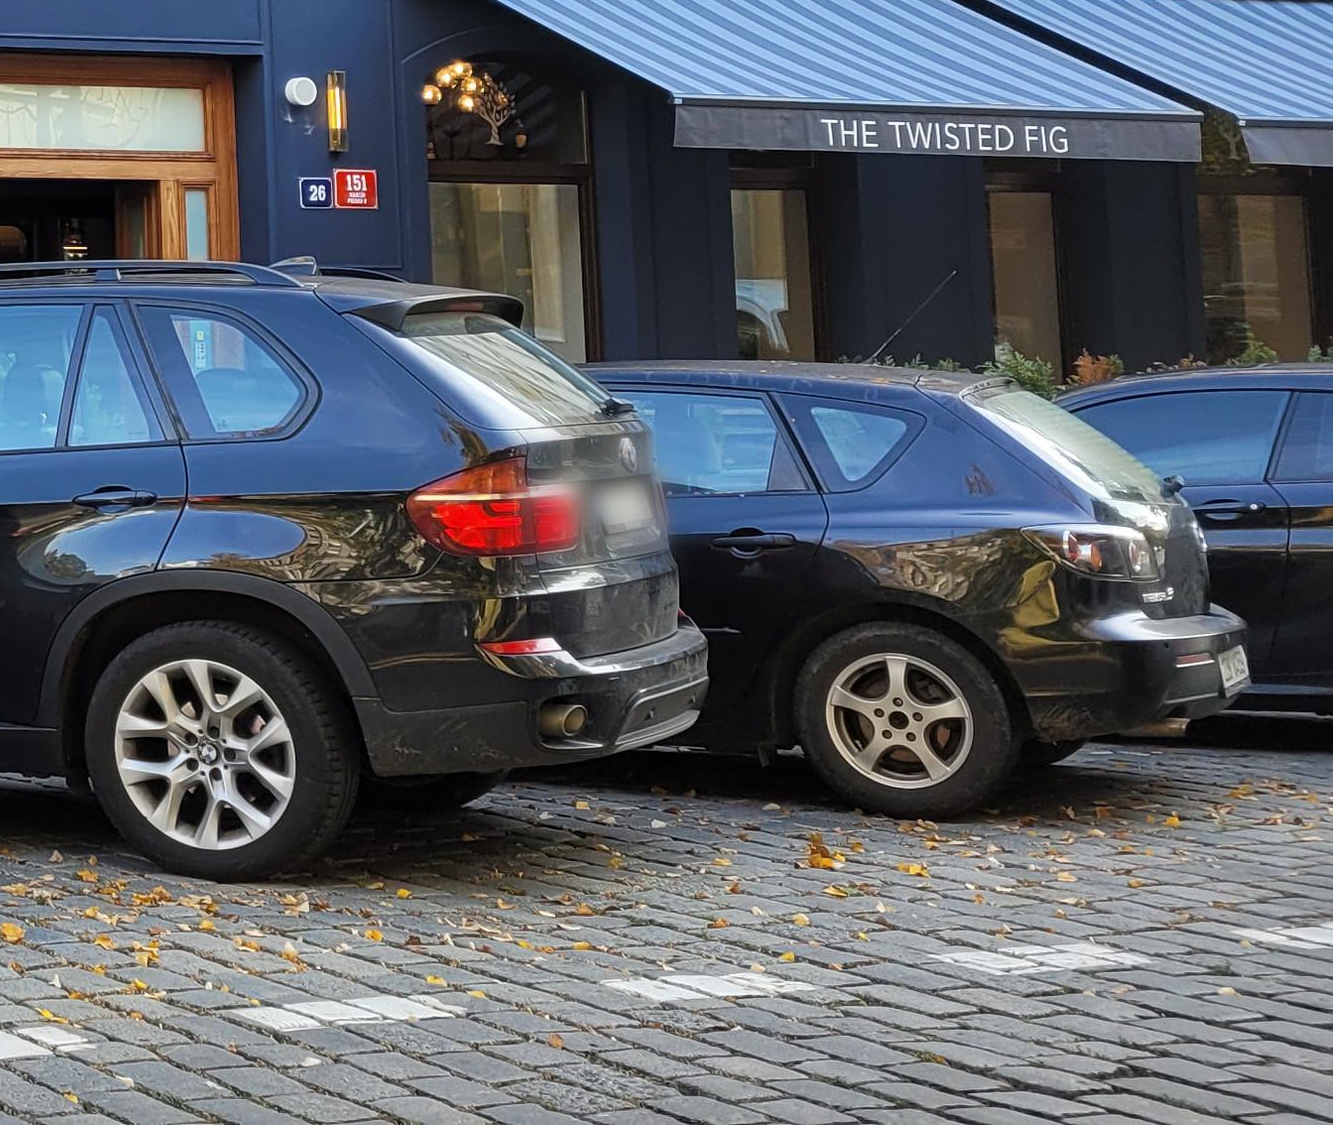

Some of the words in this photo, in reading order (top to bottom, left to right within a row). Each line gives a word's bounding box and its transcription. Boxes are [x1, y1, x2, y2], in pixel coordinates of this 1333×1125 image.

[820, 118, 879, 148] THE
[887, 121, 1015, 151] TWISTED
[1024, 125, 1069, 154] FIG
[346, 174, 368, 192] 151
[309, 184, 327, 202] 26
